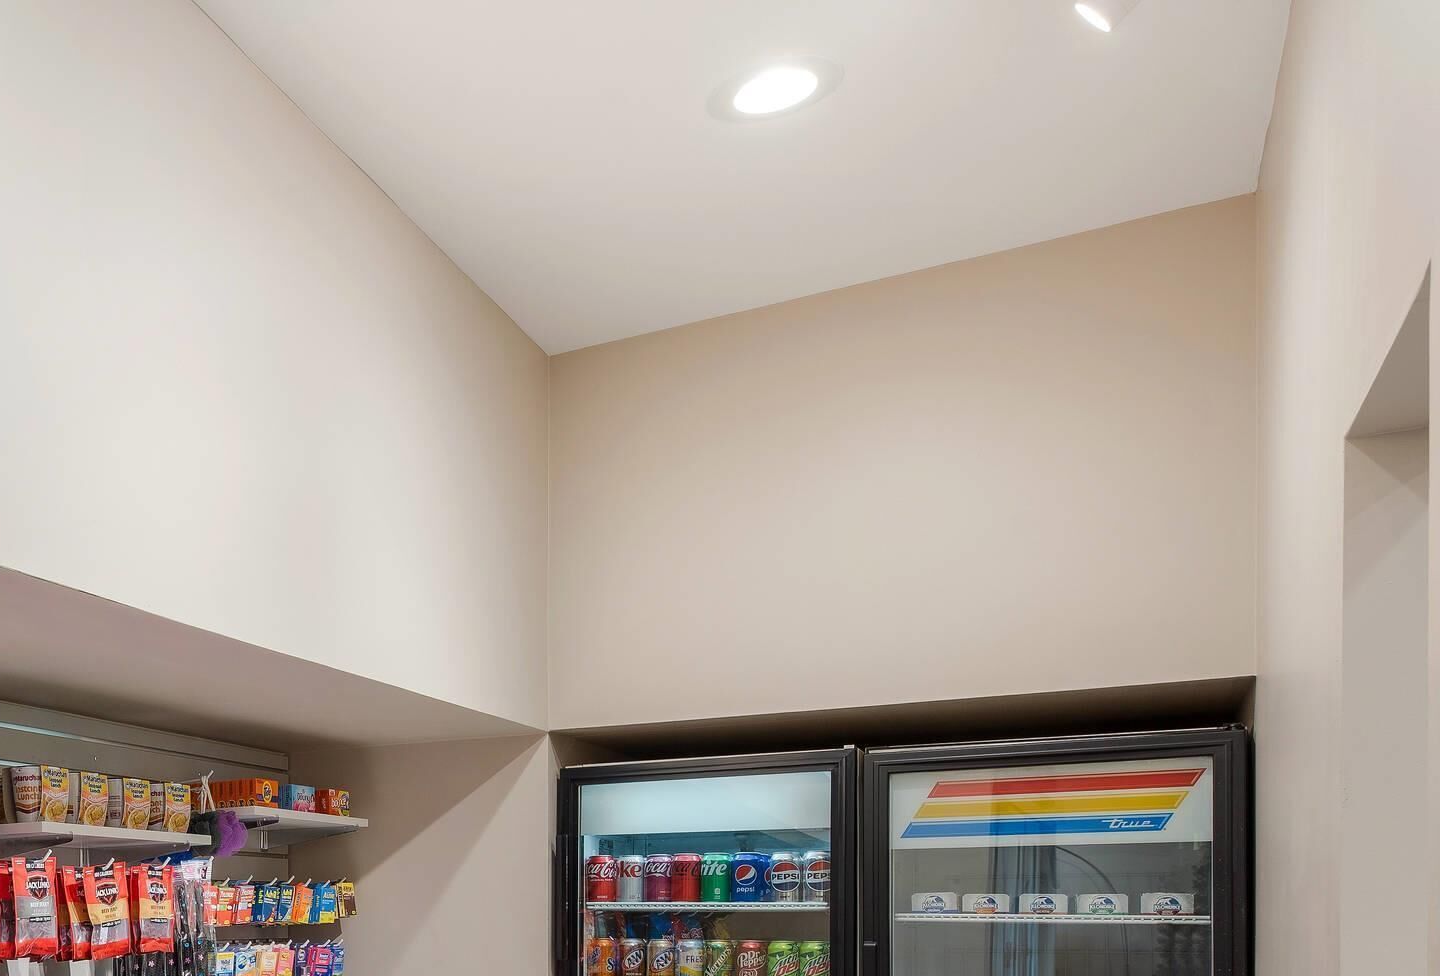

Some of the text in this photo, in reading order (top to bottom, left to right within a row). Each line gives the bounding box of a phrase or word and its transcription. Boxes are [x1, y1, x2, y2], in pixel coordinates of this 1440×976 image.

[1108, 817, 1156, 830] true
[620, 860, 642, 878] ke
[702, 859, 728, 876] rite
[771, 873, 800, 881] PEPSI
[735, 886, 756, 894] pepsi
[685, 955, 704, 964] FRES
[736, 950, 766, 972] Pepper
